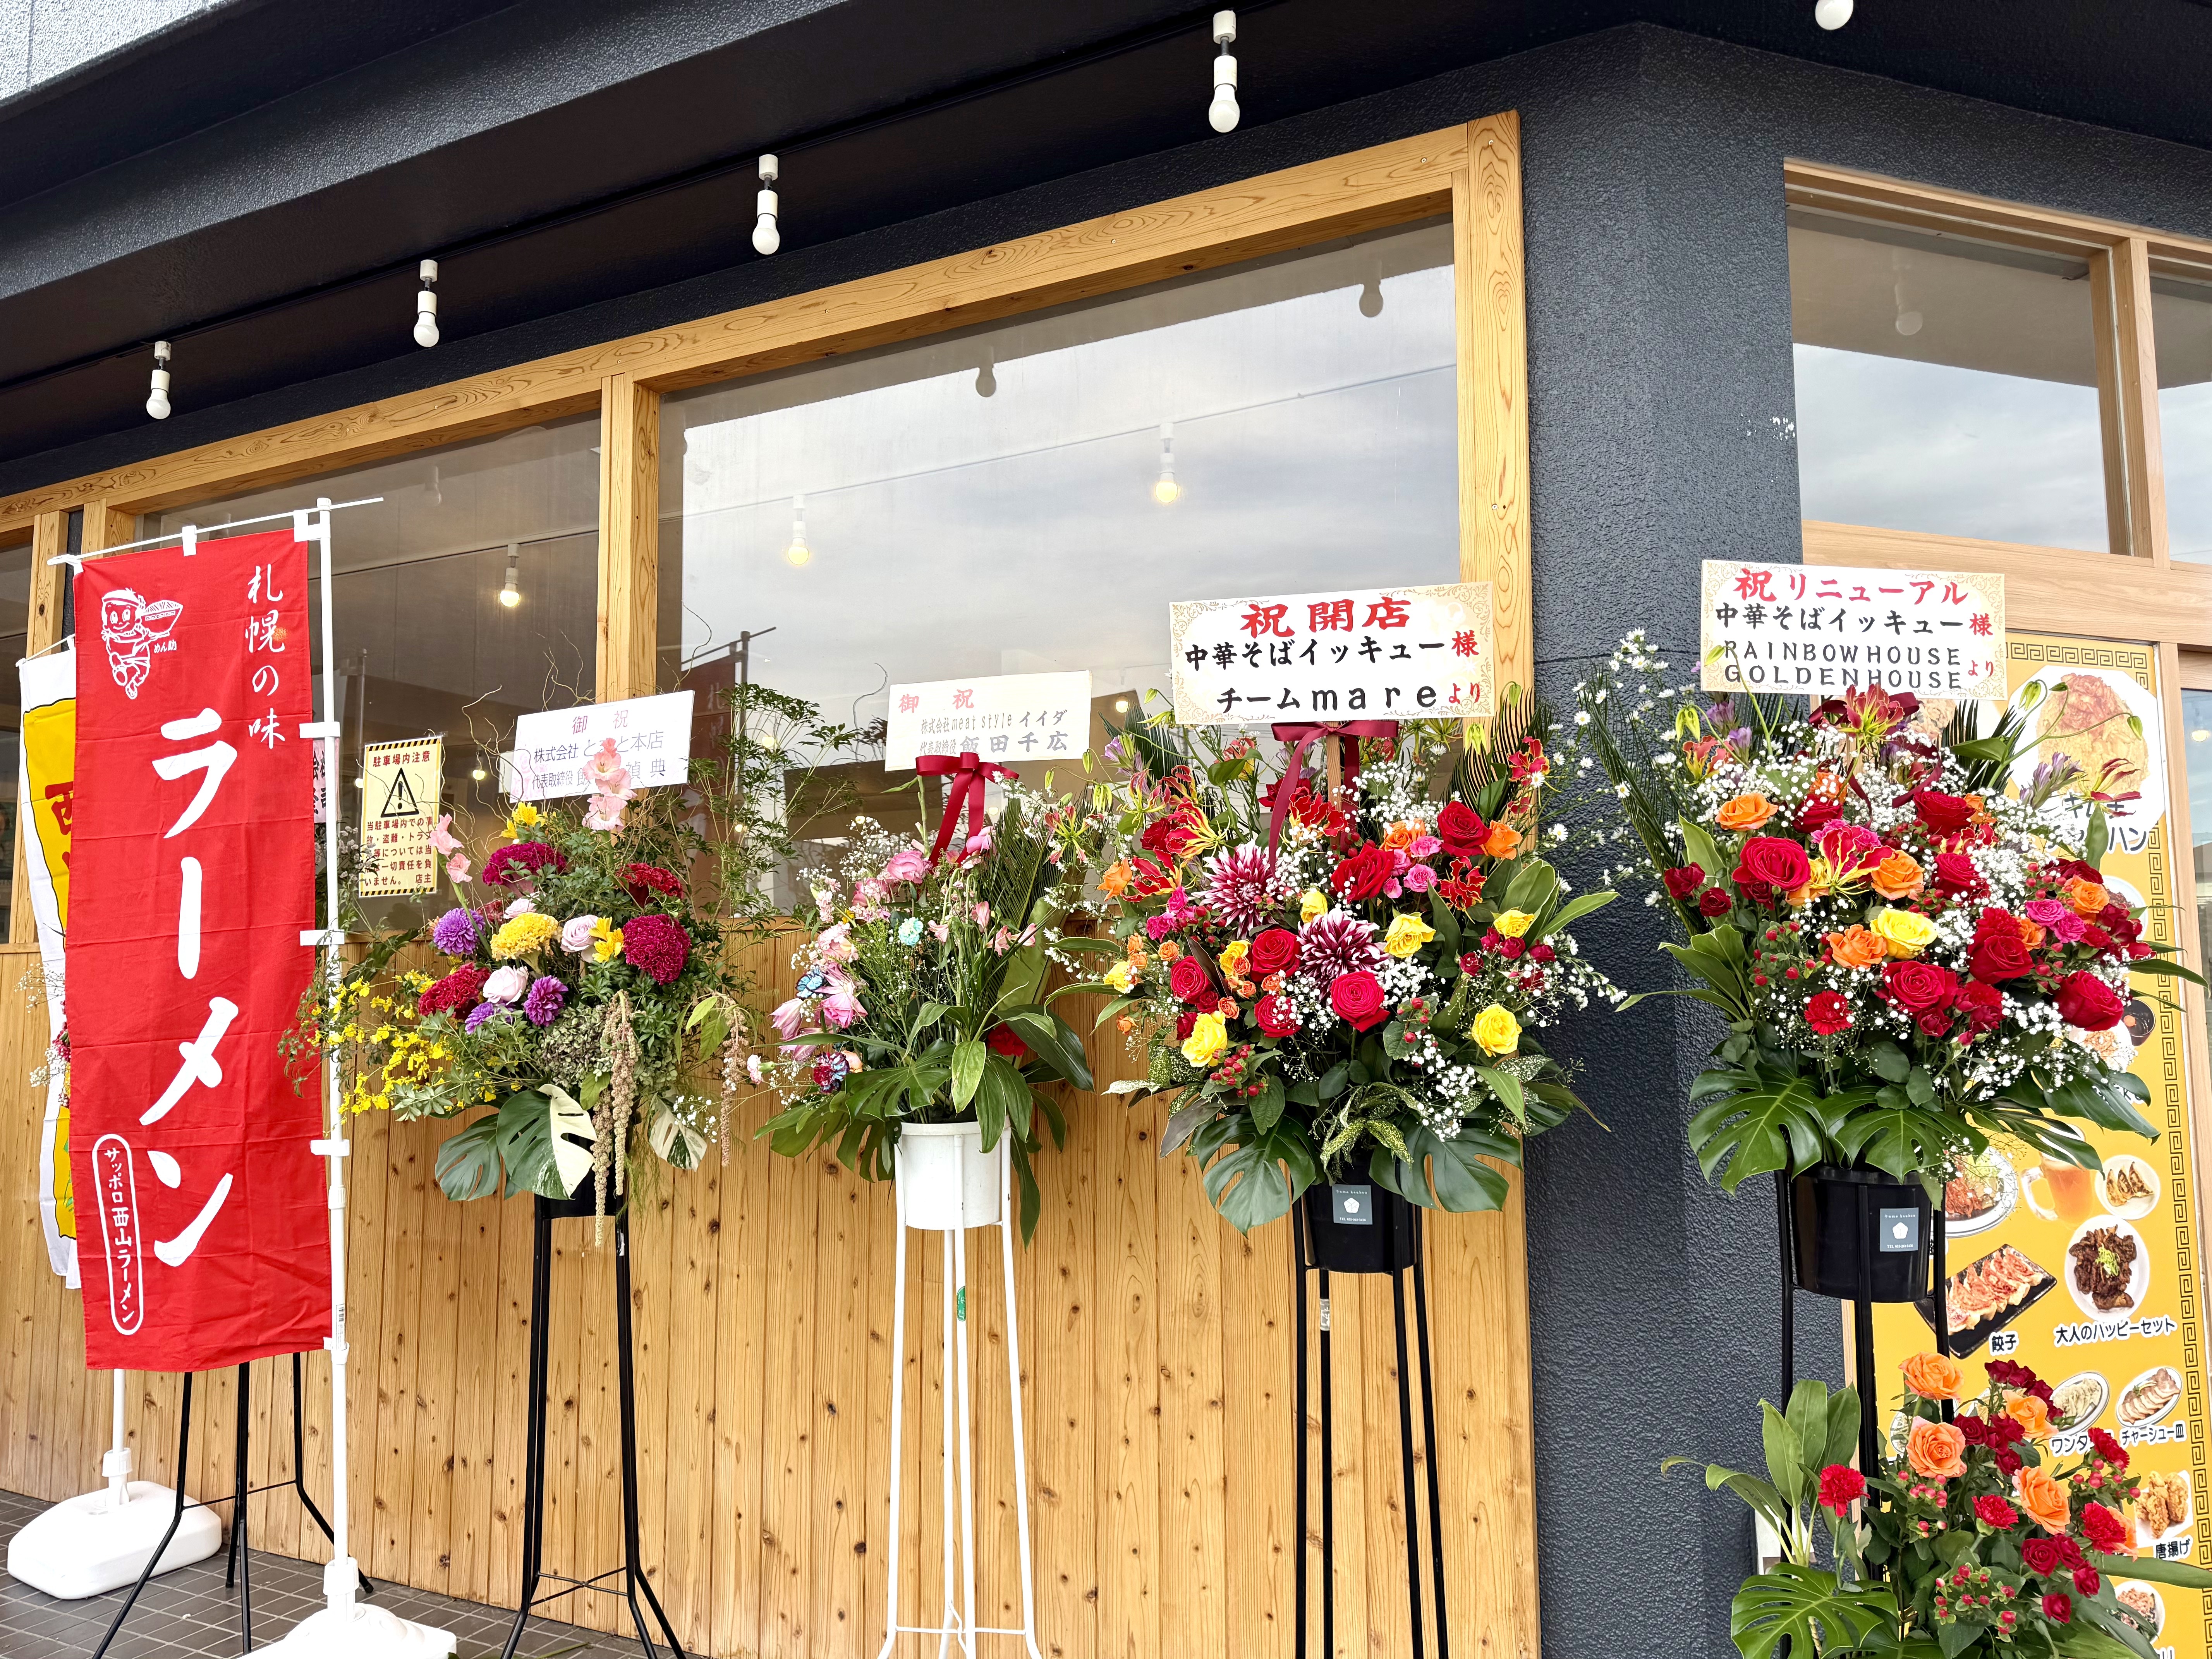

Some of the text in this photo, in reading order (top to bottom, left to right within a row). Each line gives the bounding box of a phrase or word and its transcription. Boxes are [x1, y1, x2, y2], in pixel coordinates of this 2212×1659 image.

[154, 639, 177, 653] めん助
[245, 563, 285, 749] 札幌の味
[1968, 660, 1993, 677] より
[373, 751, 430, 767] 駐車場内注意
[374, 845, 431, 858] 等については当
[139, 708, 239, 1266] ラーメン
[104, 1148, 134, 1322] サッポロ西山ラーメン
[2056, 1319, 2176, 1343] 大人のハッピーセット
[1992, 1333, 2016, 1353] 餃子
[2122, 1424, 2184, 1446] チャーシュー皿
[2156, 1538, 2190, 1559] 唐揚げ
